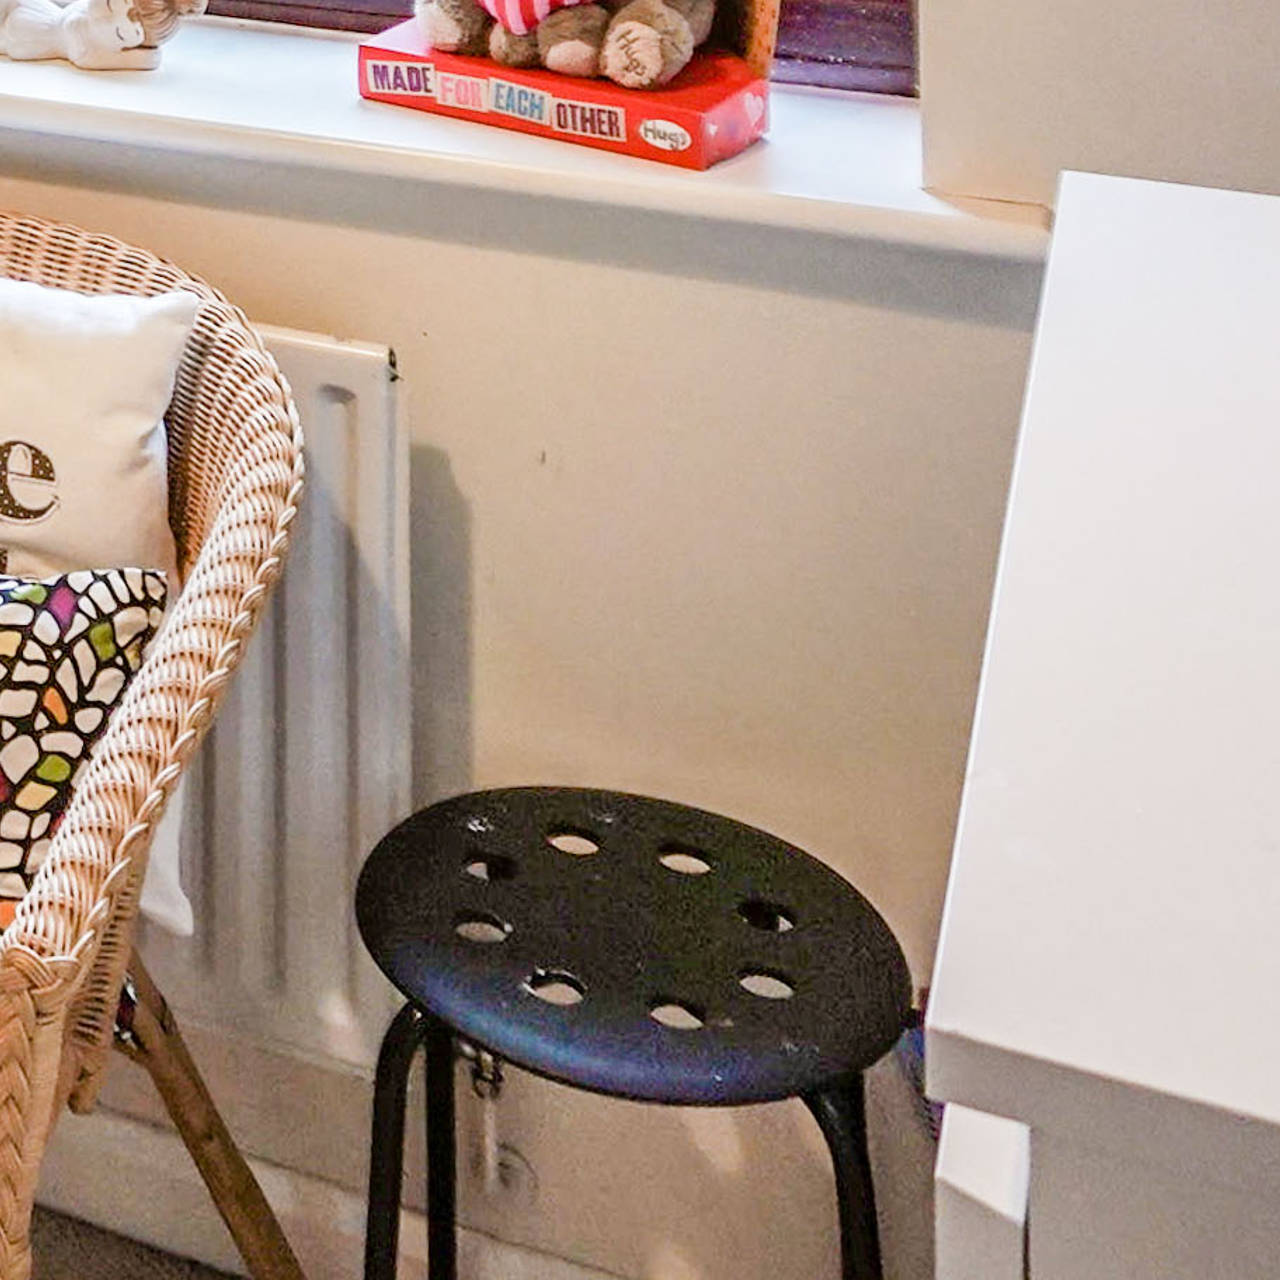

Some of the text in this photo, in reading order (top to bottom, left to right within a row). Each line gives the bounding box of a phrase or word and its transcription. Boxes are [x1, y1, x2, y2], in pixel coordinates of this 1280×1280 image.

[371, 63, 622, 138] MADE FOR EACH OTHER
[643, 122, 688, 152] Hugs
